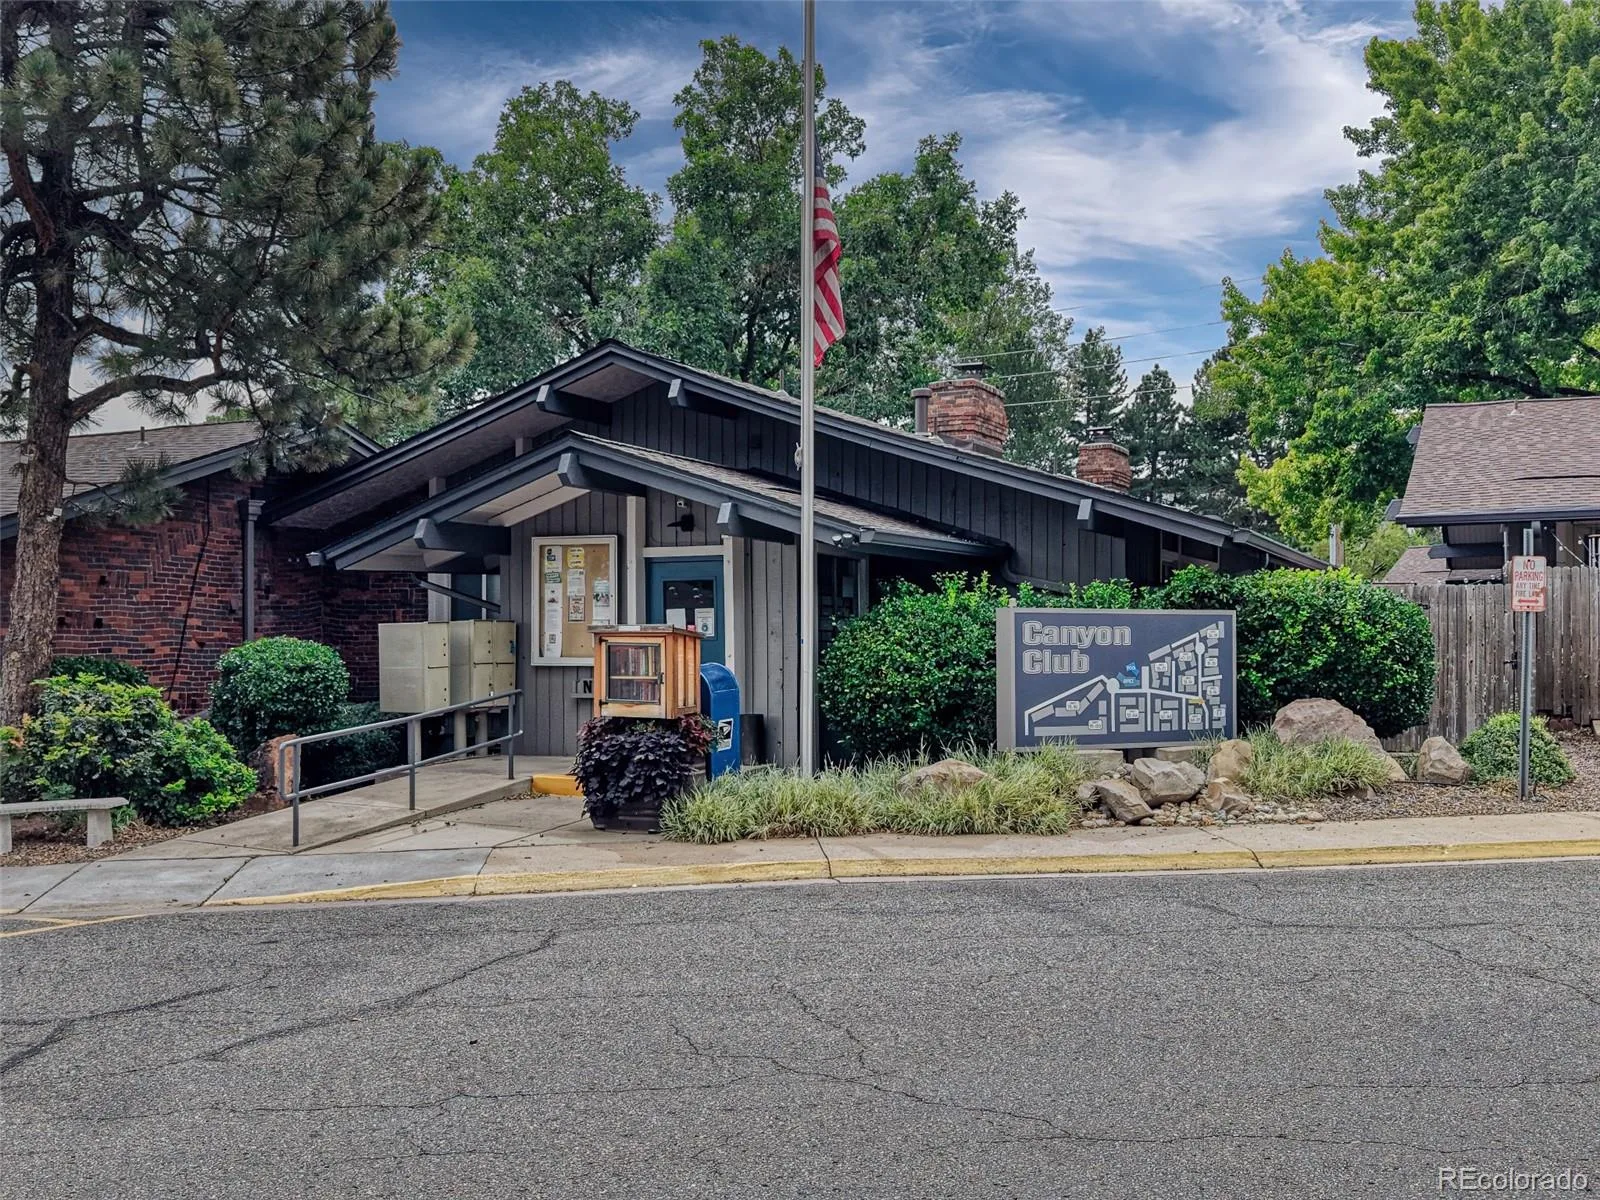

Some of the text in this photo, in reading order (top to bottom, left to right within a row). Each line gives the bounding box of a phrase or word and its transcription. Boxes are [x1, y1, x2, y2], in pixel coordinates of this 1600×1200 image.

[1523, 560, 1536, 570] NO
[1514, 571, 1544, 581] PARKING
[1022, 620, 1132, 649] Canyon
[1023, 649, 1090, 675] Club
